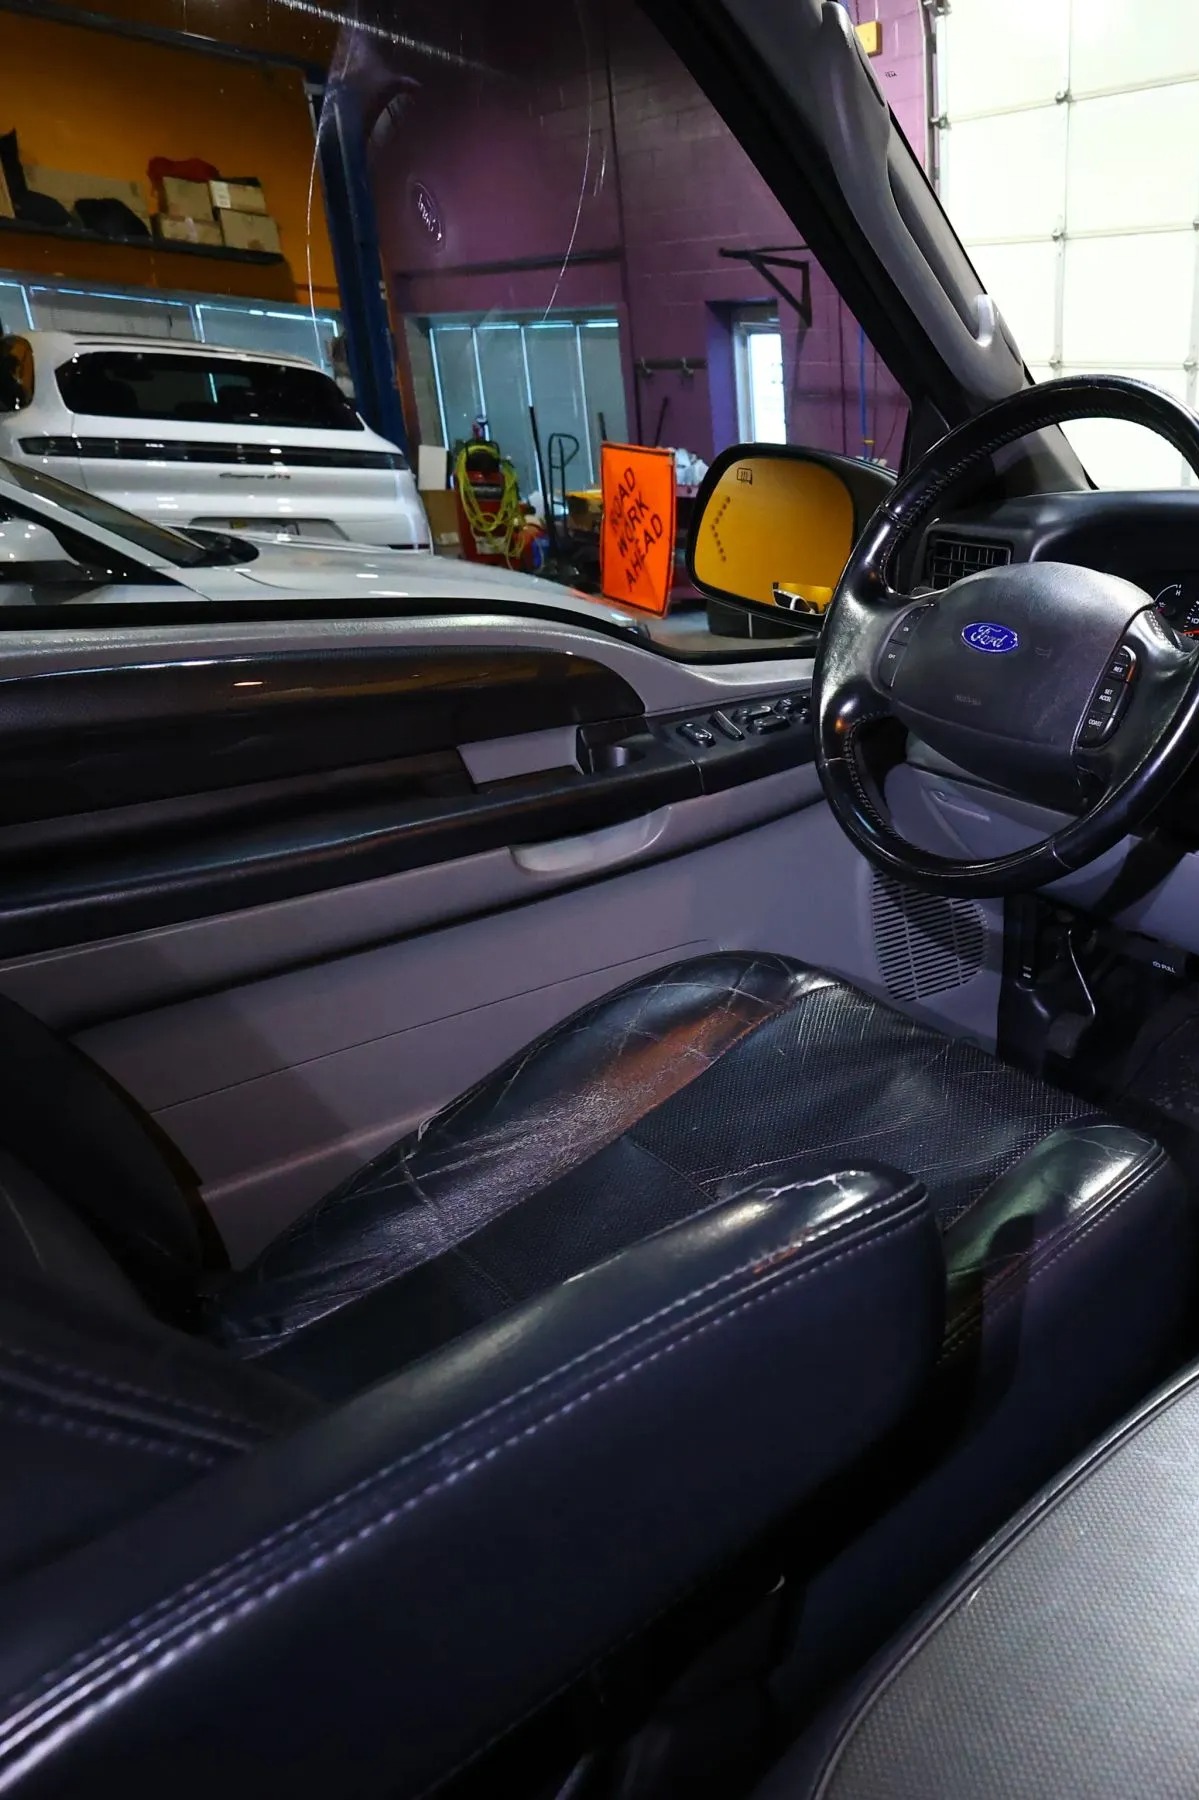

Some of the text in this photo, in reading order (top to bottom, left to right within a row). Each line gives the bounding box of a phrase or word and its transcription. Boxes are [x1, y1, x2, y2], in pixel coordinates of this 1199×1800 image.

[610, 467, 637, 535] ROAD
[617, 491, 650, 558] WORK
[625, 513, 663, 593] AHEAD
[971, 625, 1009, 648] Ford
[1191, 617, 1199, 625] 10
